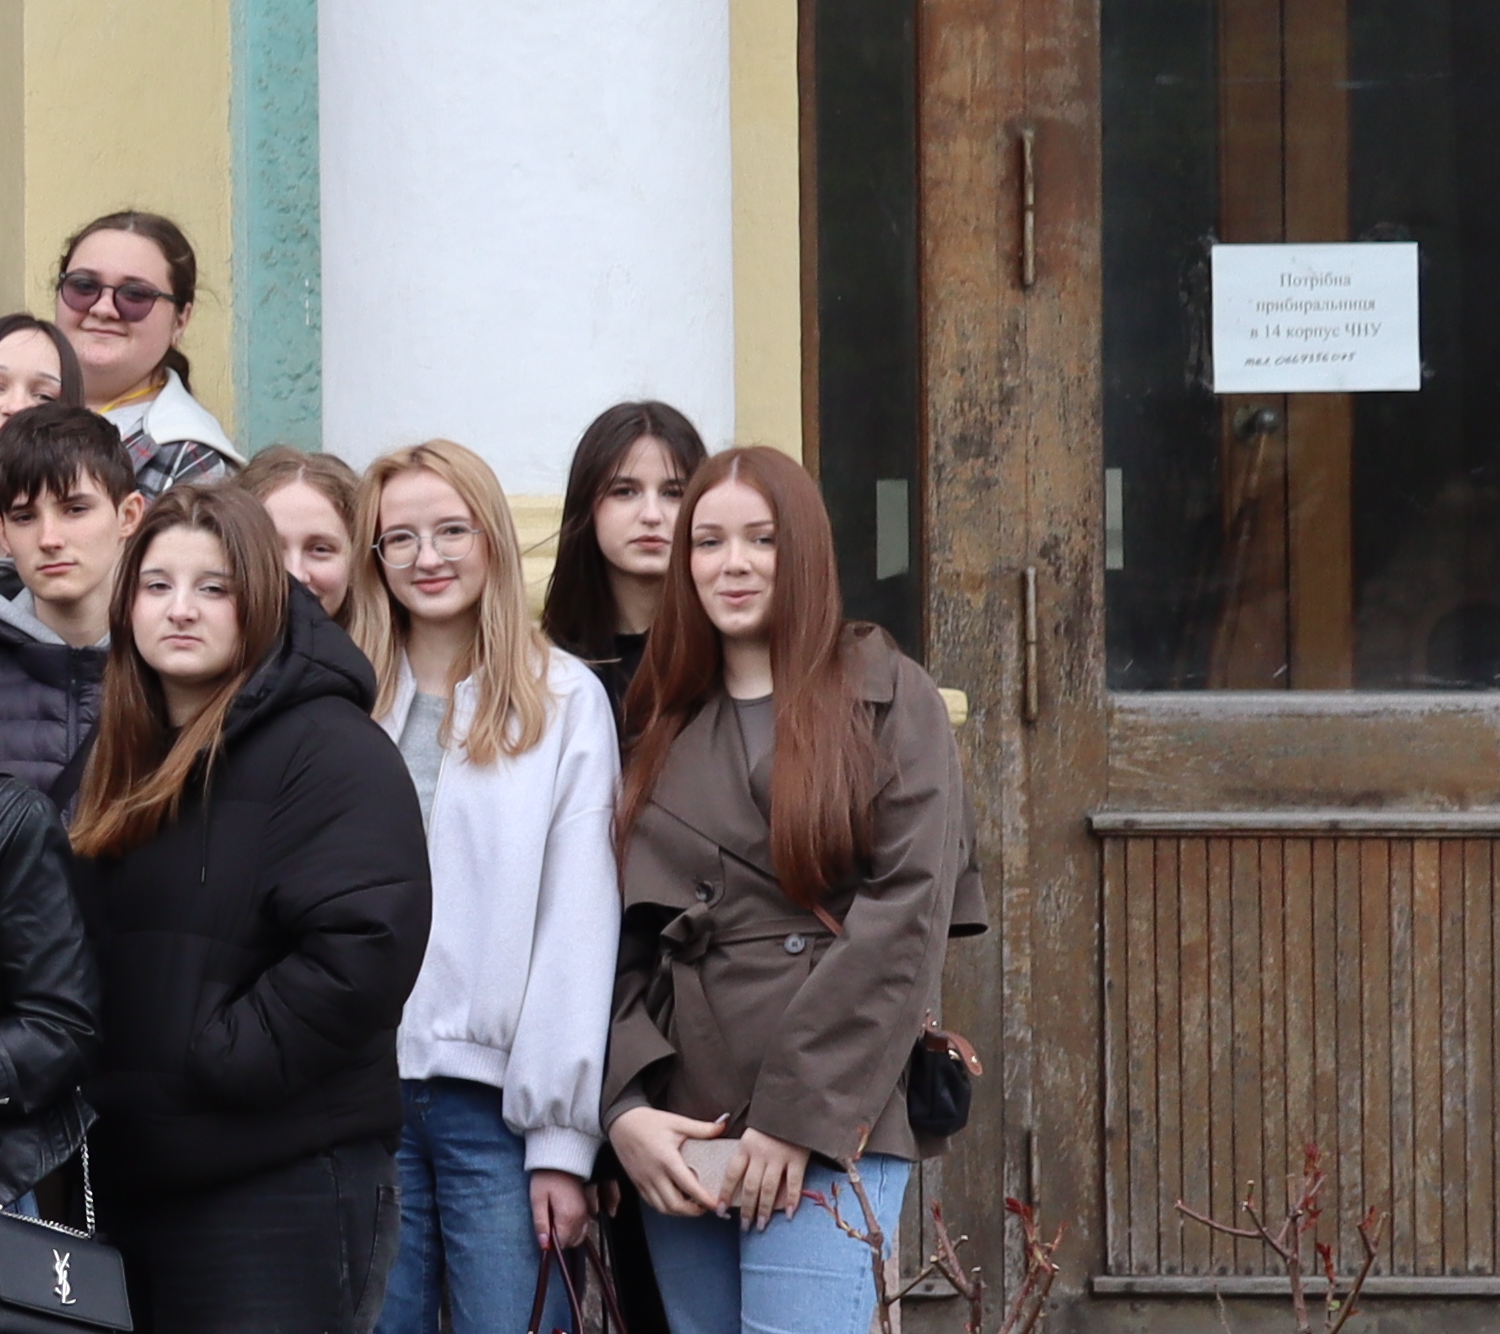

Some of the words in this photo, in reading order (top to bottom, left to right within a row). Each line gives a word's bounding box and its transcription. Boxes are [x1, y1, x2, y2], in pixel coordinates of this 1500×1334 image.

[1279, 272, 1352, 290] Потрібна
[1256, 297, 1376, 315] прибиральниця
[1250, 328, 1259, 338] в
[1265, 324, 1281, 338] 14
[1286, 326, 1341, 341] корпус
[1345, 322, 1382, 338] ЧНУ
